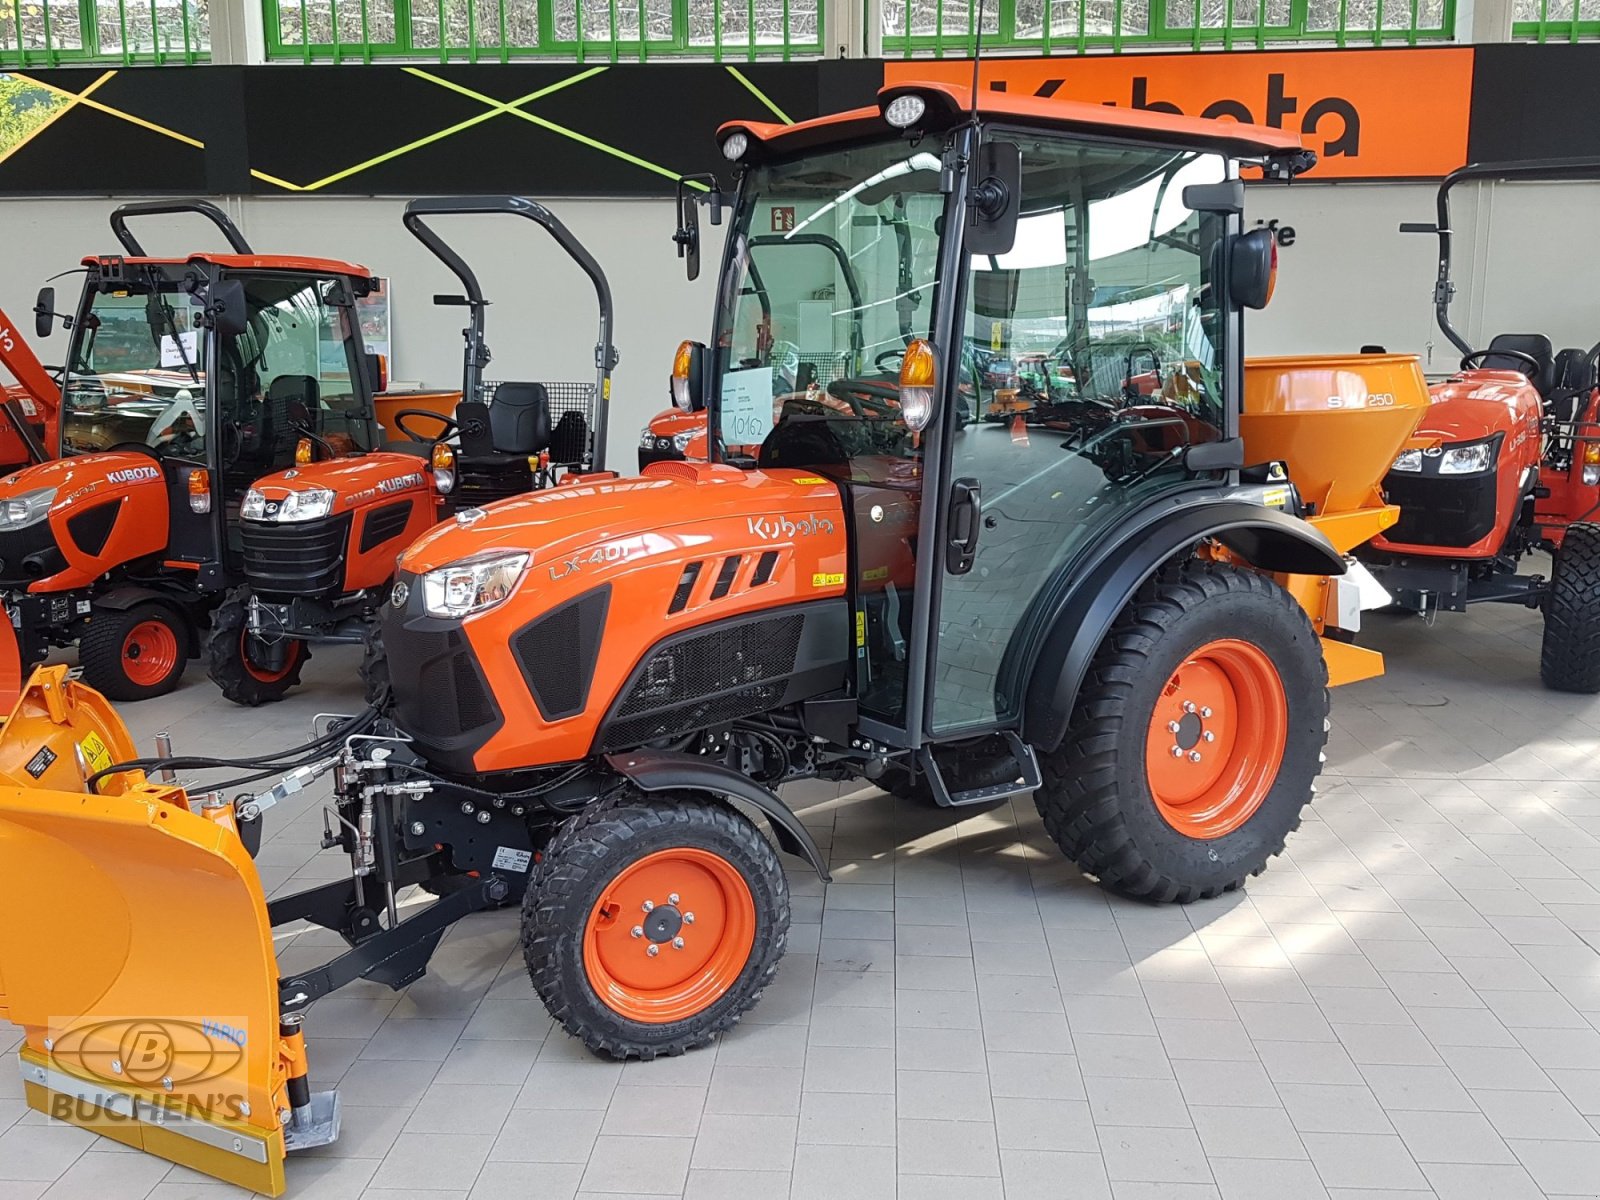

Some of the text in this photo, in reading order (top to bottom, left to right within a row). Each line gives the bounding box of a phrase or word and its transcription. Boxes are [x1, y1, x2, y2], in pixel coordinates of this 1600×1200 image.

[1368, 393, 1394, 407] 250
[731, 415, 763, 439] 10162
[106, 466, 159, 484] KUBOTA
[377, 472, 424, 494] KUBOTA
[747, 513, 834, 539] Kubota
[202, 1019, 247, 1047] VARIO
